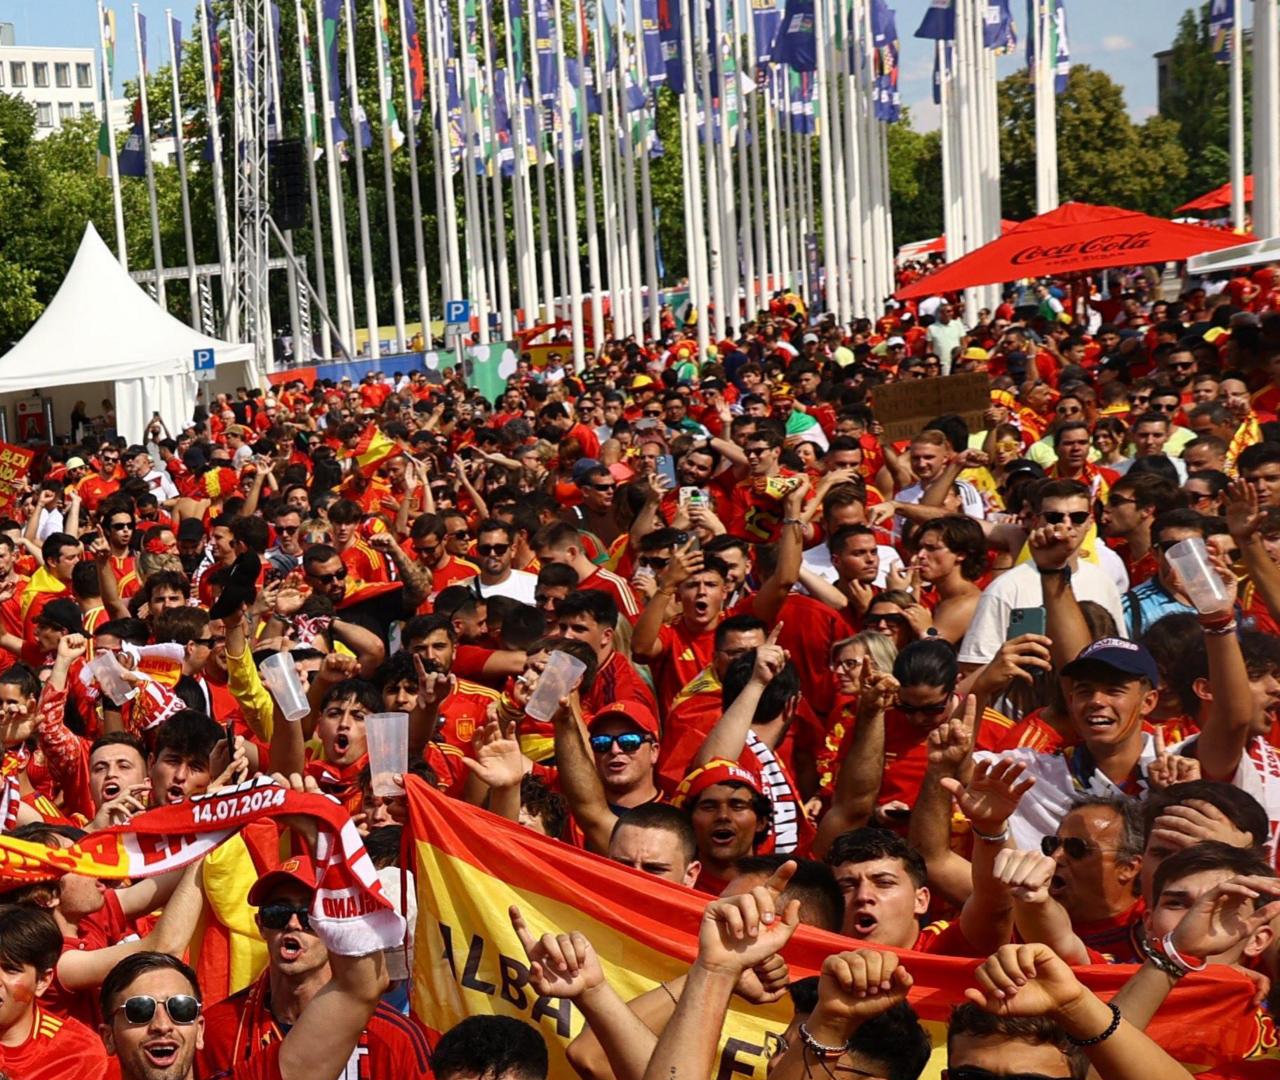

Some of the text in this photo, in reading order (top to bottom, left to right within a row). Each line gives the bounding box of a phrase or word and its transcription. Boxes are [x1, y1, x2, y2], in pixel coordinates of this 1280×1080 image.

[451, 303, 465, 321] P
[197, 351, 210, 368] P
[192, 788, 286, 824] 14.07.2024
